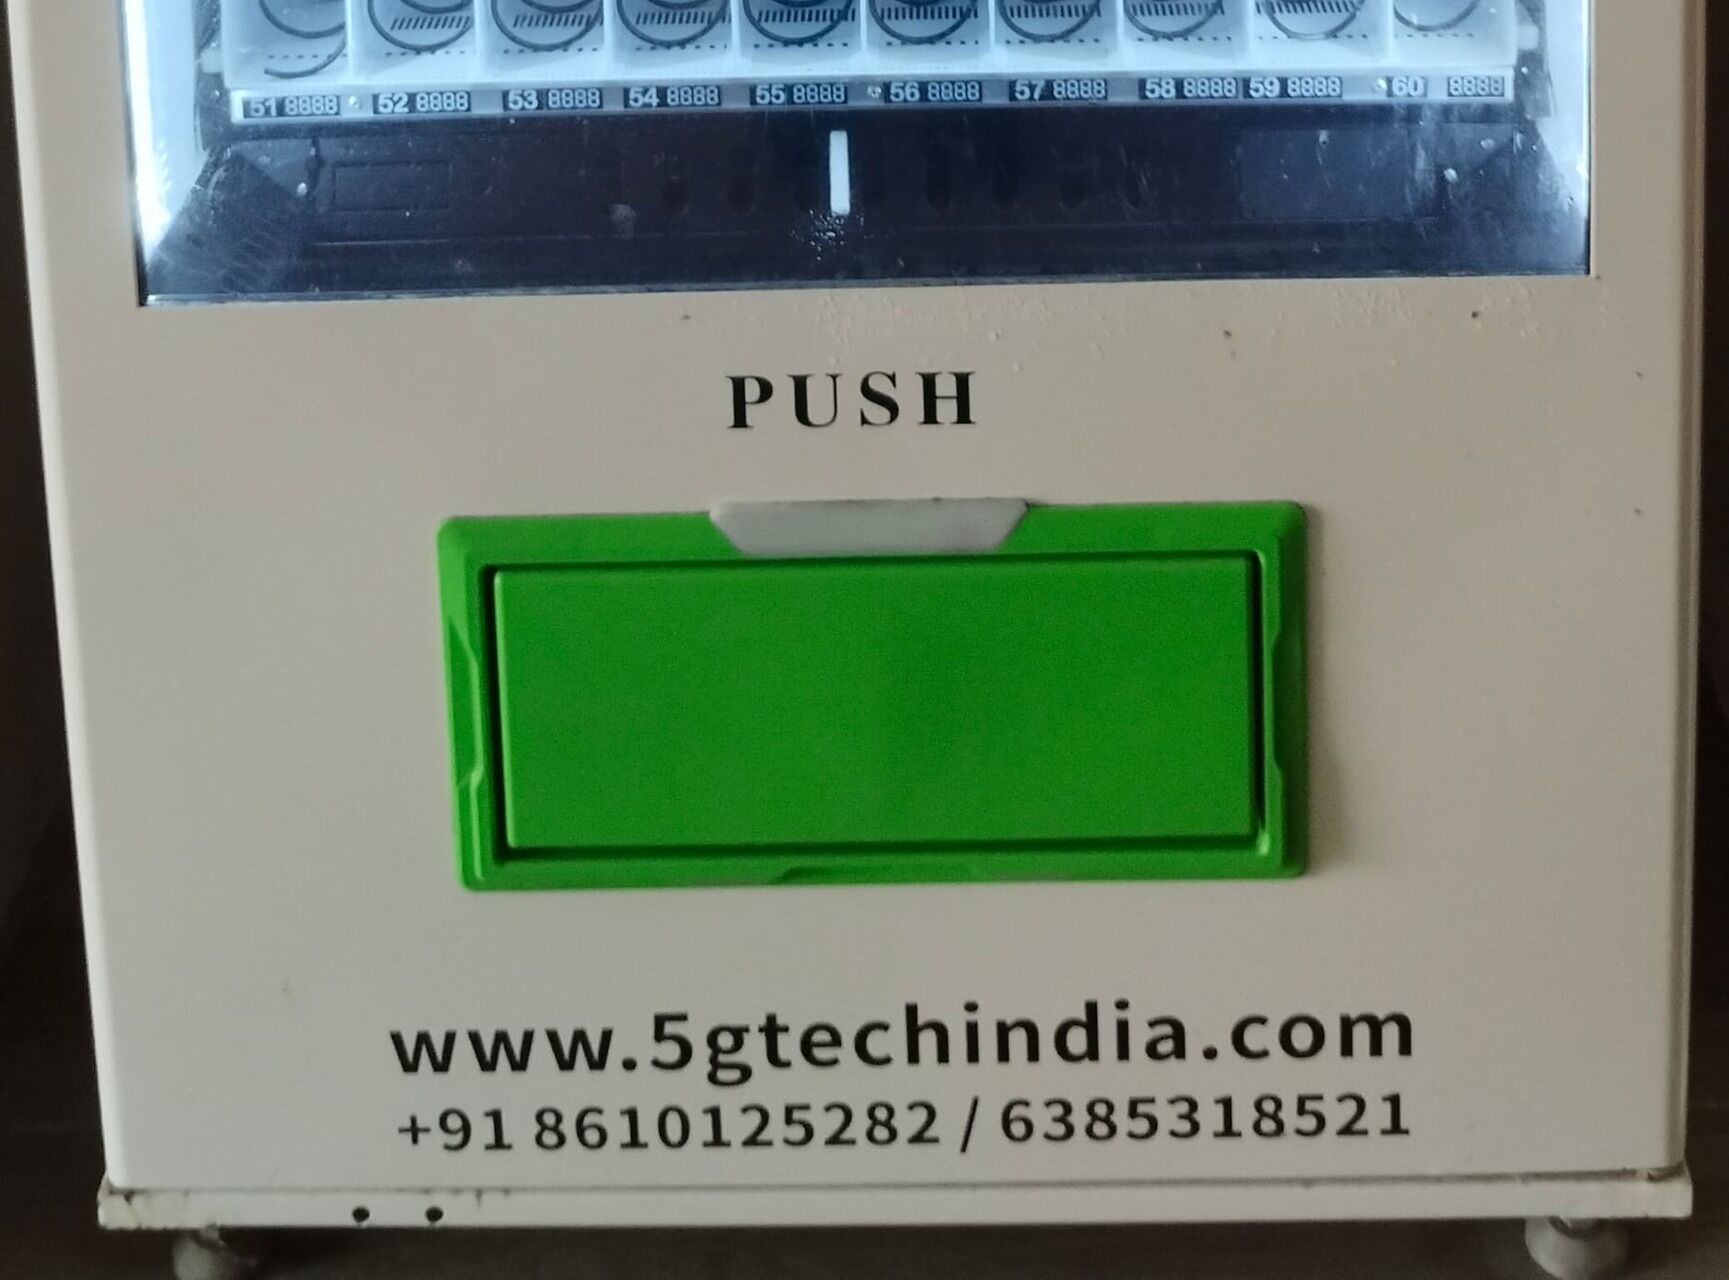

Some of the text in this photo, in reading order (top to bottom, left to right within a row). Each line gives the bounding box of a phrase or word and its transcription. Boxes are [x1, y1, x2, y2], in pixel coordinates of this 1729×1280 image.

[628, 86, 659, 107] 54
[755, 84, 785, 105] 55
[889, 81, 921, 103] 56
[1014, 79, 1046, 100] 57
[1144, 77, 1176, 98] 58
[1249, 77, 1280, 98] 59
[1392, 76, 1424, 97] 60
[249, 97, 277, 117] 51
[377, 92, 410, 114] 52
[507, 89, 539, 111] 53
[725, 371, 977, 429] PUSH
[390, 998, 1413, 1086] www.5gtechindia.com
[398, 1092, 1411, 1153] +91 8610125282 / 6385318521
